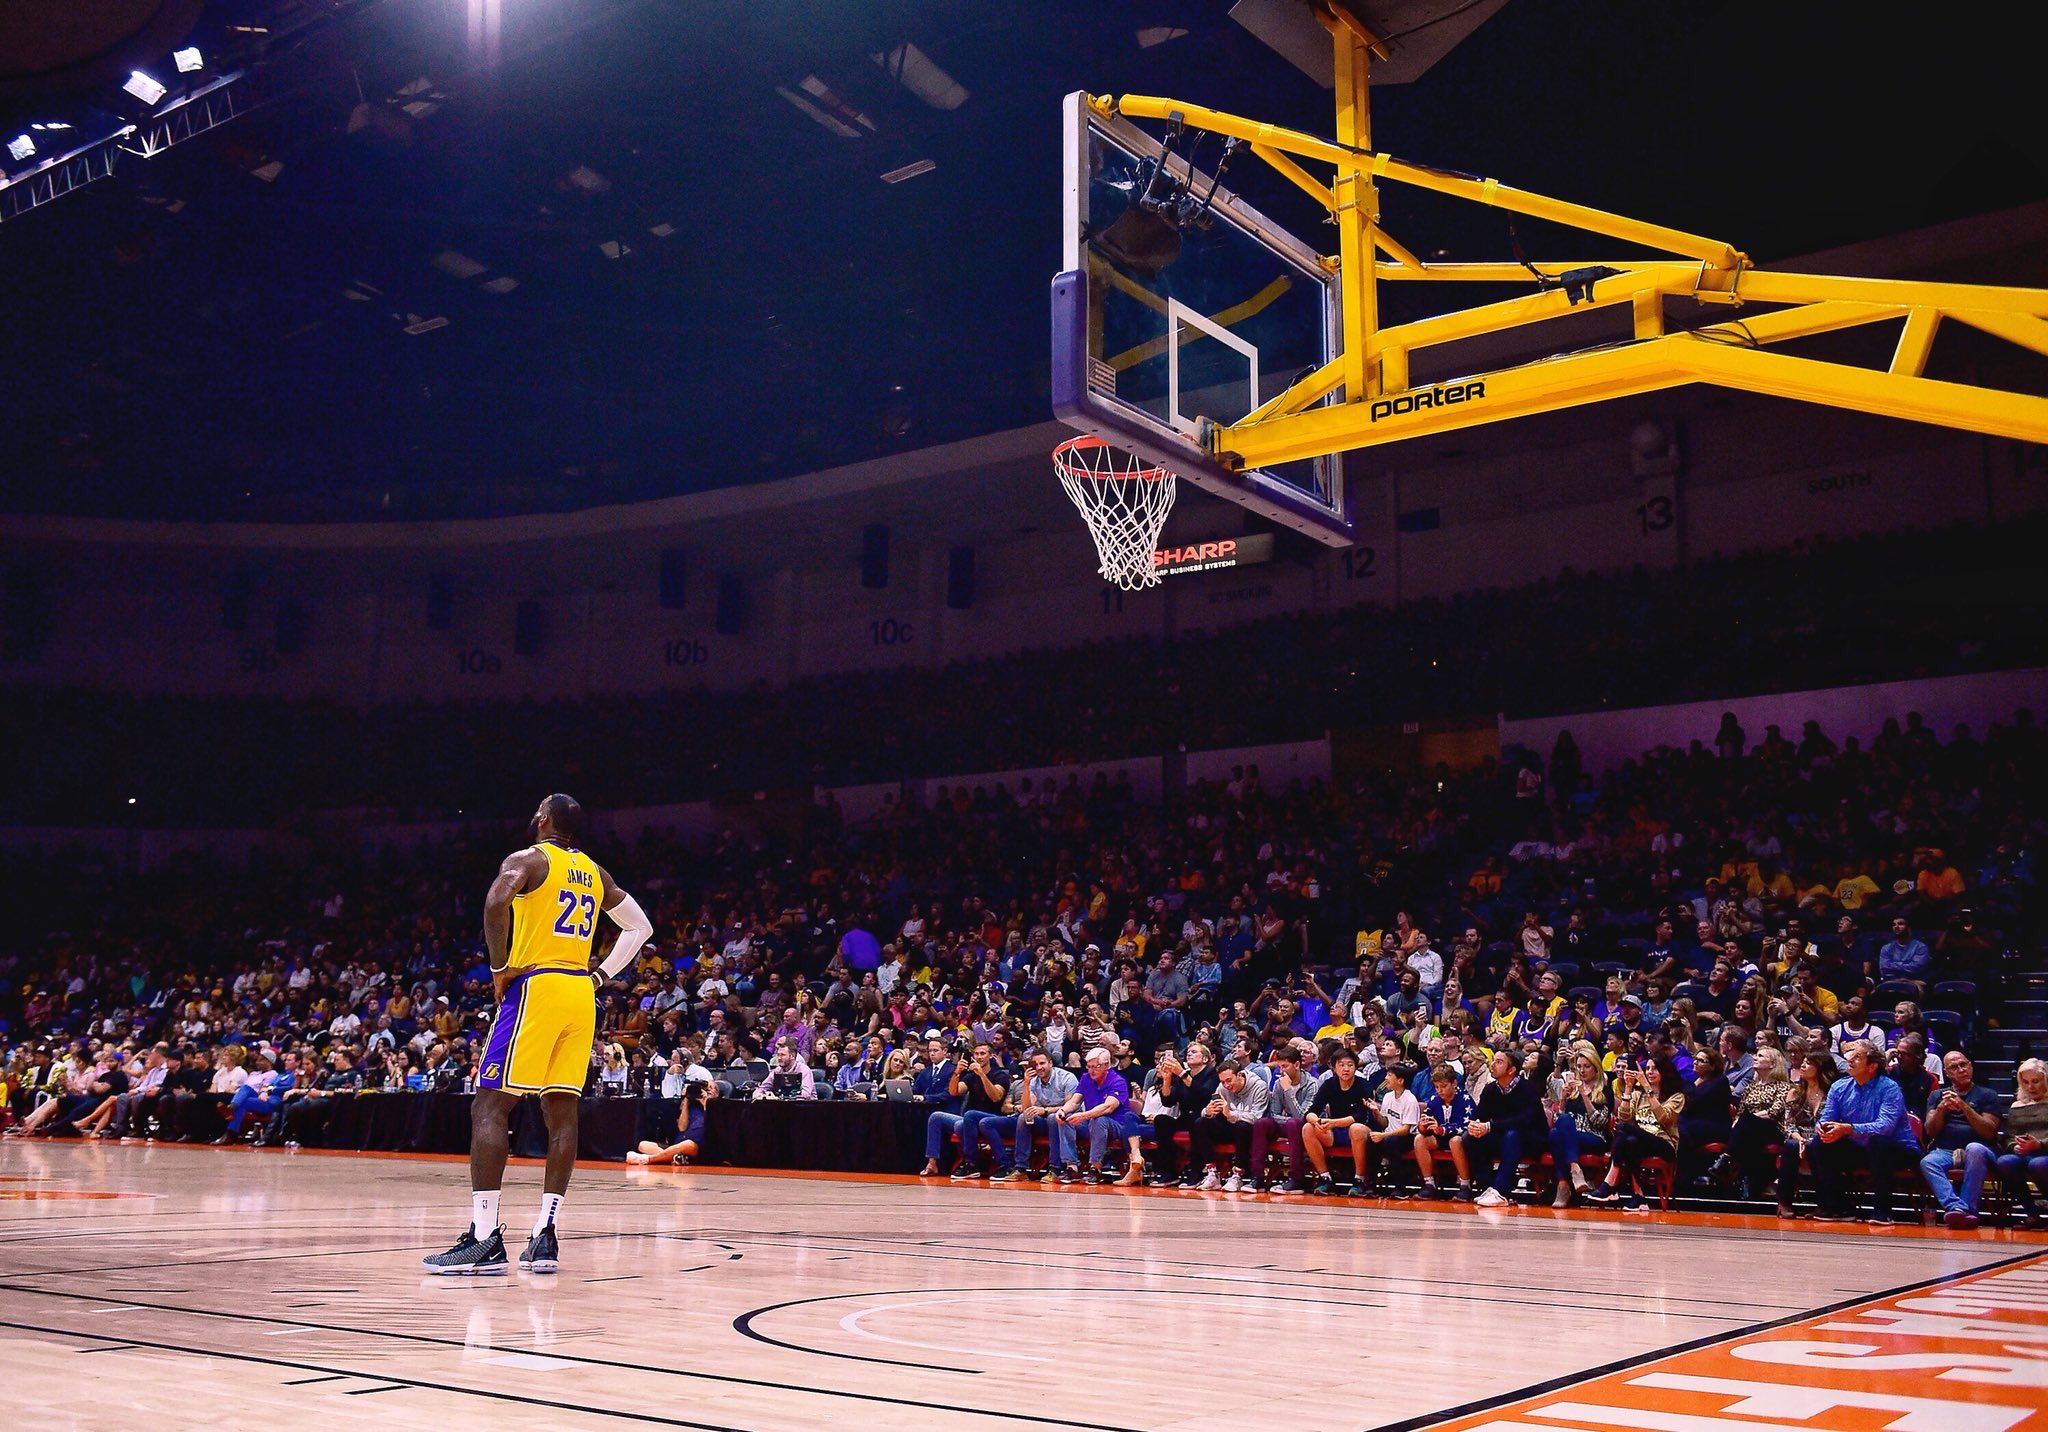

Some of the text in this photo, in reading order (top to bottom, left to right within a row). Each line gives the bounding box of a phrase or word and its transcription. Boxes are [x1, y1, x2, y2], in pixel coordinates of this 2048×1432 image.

[1807, 472, 1872, 495] SOUTH
[1637, 495, 1675, 537] 13
[1153, 540, 1236, 567] SHARP
[1170, 564, 1202, 575] BUSINESS
[1204, 559, 1236, 570] SYSTEMS
[1341, 546, 1377, 580] 12
[1100, 586, 1123, 614] 11
[870, 618, 914, 646] 10c
[457, 649, 501, 675] 10a
[663, 638, 708, 667] 10b
[567, 868, 593, 888] JAMES
[553, 888, 596, 941] 23
